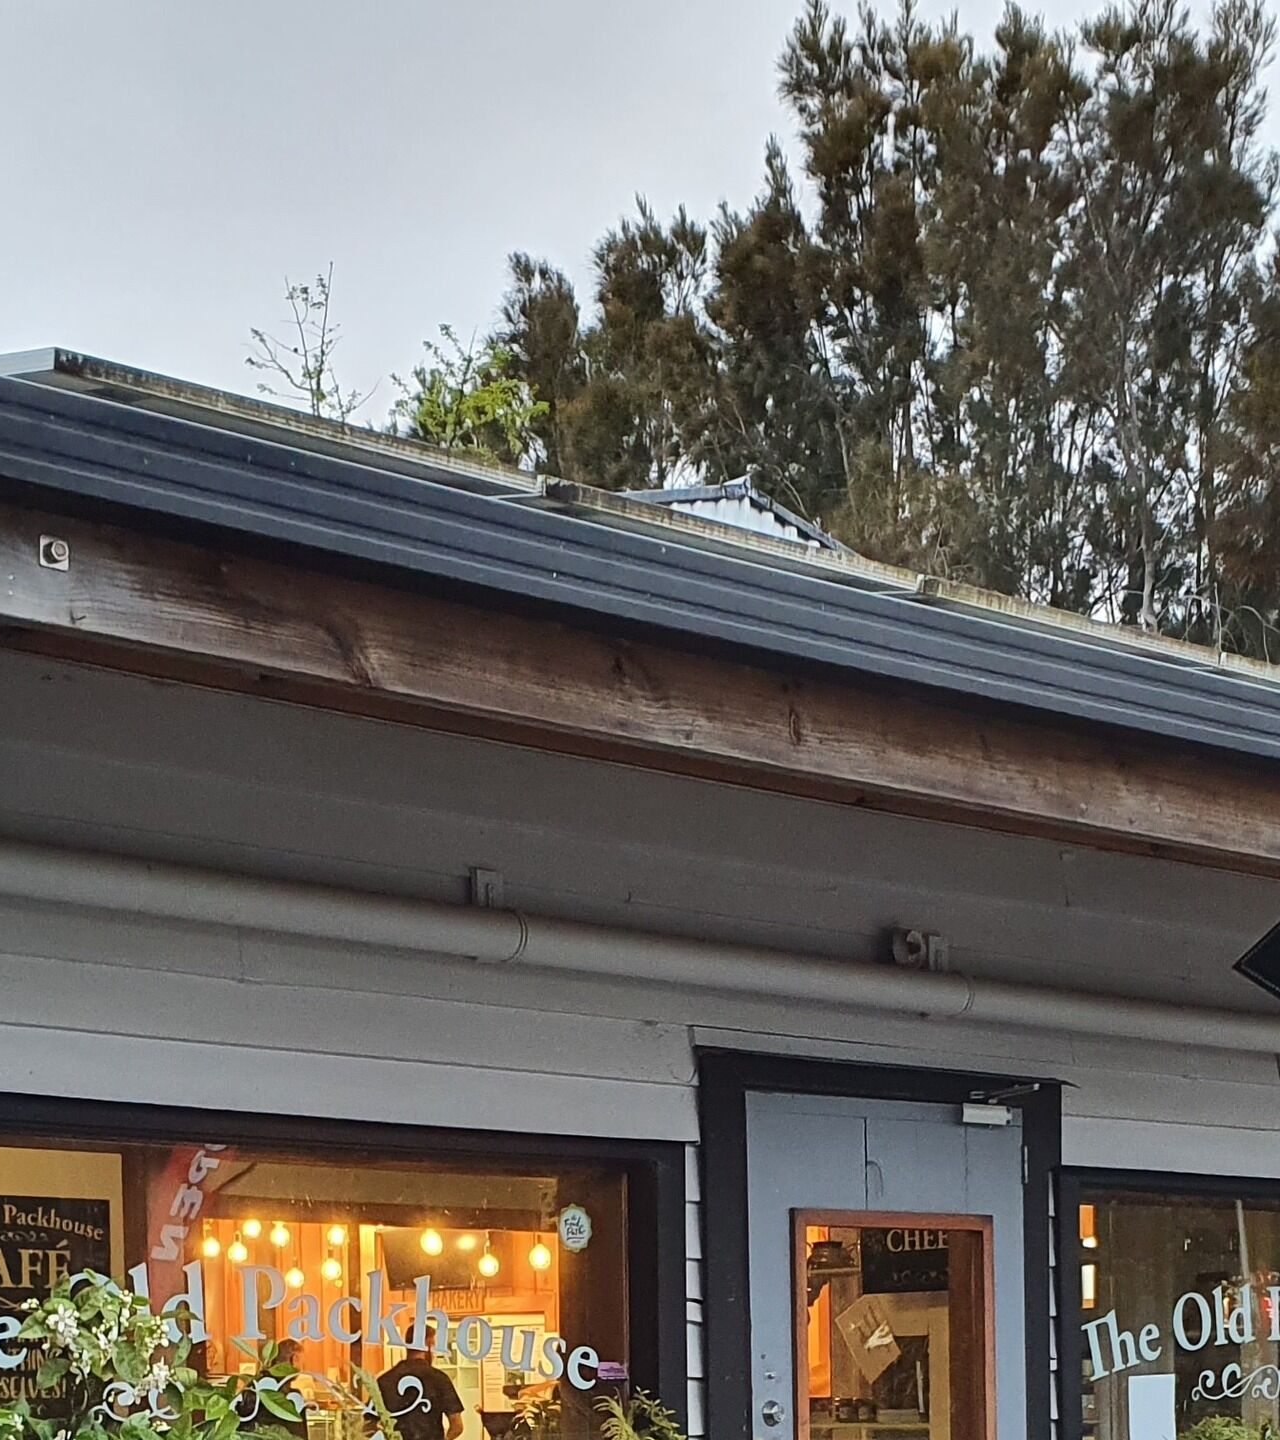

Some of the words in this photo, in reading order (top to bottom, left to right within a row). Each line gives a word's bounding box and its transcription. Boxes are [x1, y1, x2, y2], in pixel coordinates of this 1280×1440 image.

[3, 1204, 104, 1242] Packhouse
[237, 1263, 599, 1391] Packhouse
[432, 1290, 480, 1310] BAKERY
[1081, 1309, 1163, 1383] The
[1173, 1284, 1256, 1353] Old
